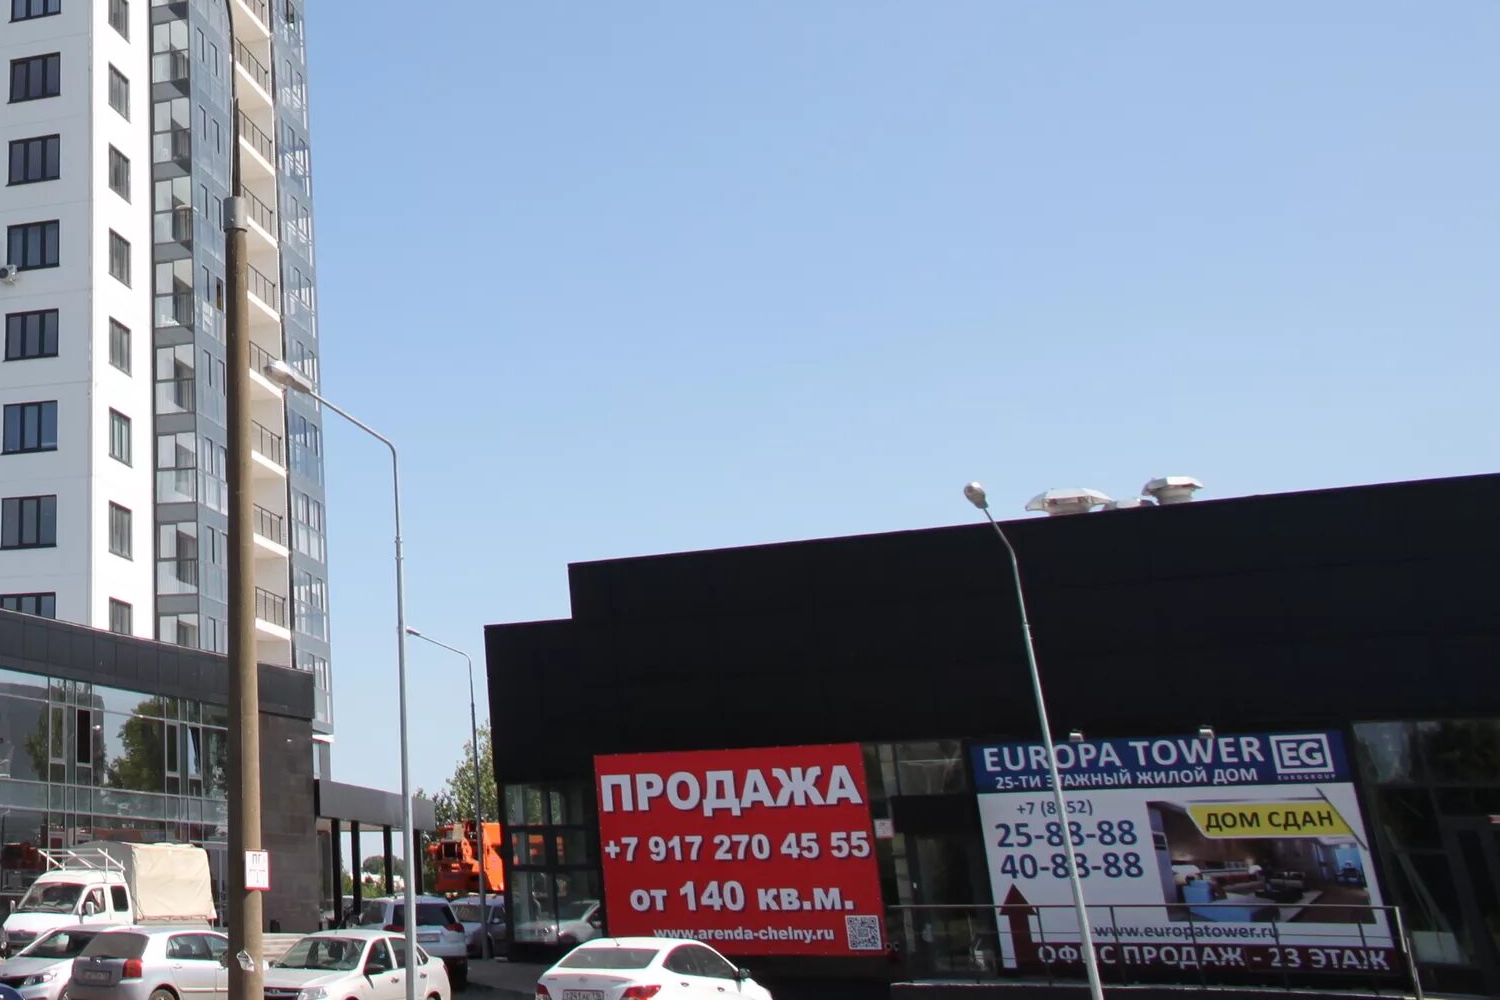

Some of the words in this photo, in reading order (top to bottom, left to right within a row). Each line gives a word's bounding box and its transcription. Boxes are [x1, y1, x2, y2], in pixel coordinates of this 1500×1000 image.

[983, 742, 1123, 772] EUROPA
[1128, 736, 1265, 767] TOWER
[1279, 741, 1324, 766] EG
[995, 774, 1041, 790] 25-ТИ
[1137, 766, 1207, 785] ЖИЛОЙ
[1213, 767, 1258, 785] ДОМ
[600, 765, 863, 817] ПРОДАЖА
[1016, 802, 1035, 815] +7
[1041, 799, 1093, 817] (852)
[1206, 811, 1260, 832] ДОМ
[1268, 810, 1334, 831] СДАН
[605, 837, 638, 861] +7
[649, 835, 702, 861] 917
[713, 834, 770, 861] 270
[780, 832, 820, 859] 45
[830, 831, 871, 858] 55
[995, 820, 1137, 848] 25-88-88
[1001, 852, 1143, 879] 40-88-88
[630, 890, 667, 912] от
[679, 881, 745, 912] 140
[653, 926, 835, 943] www.arenda-chelny.ru
[1094, 925, 1278, 940] www.europatower.ru
[1038, 945, 1116, 964] ОФС
[1123, 945, 1245, 970] ПРОДАЖ
[1268, 948, 1301, 968] 23
[1308, 948, 1390, 970] ЭТАЖ
